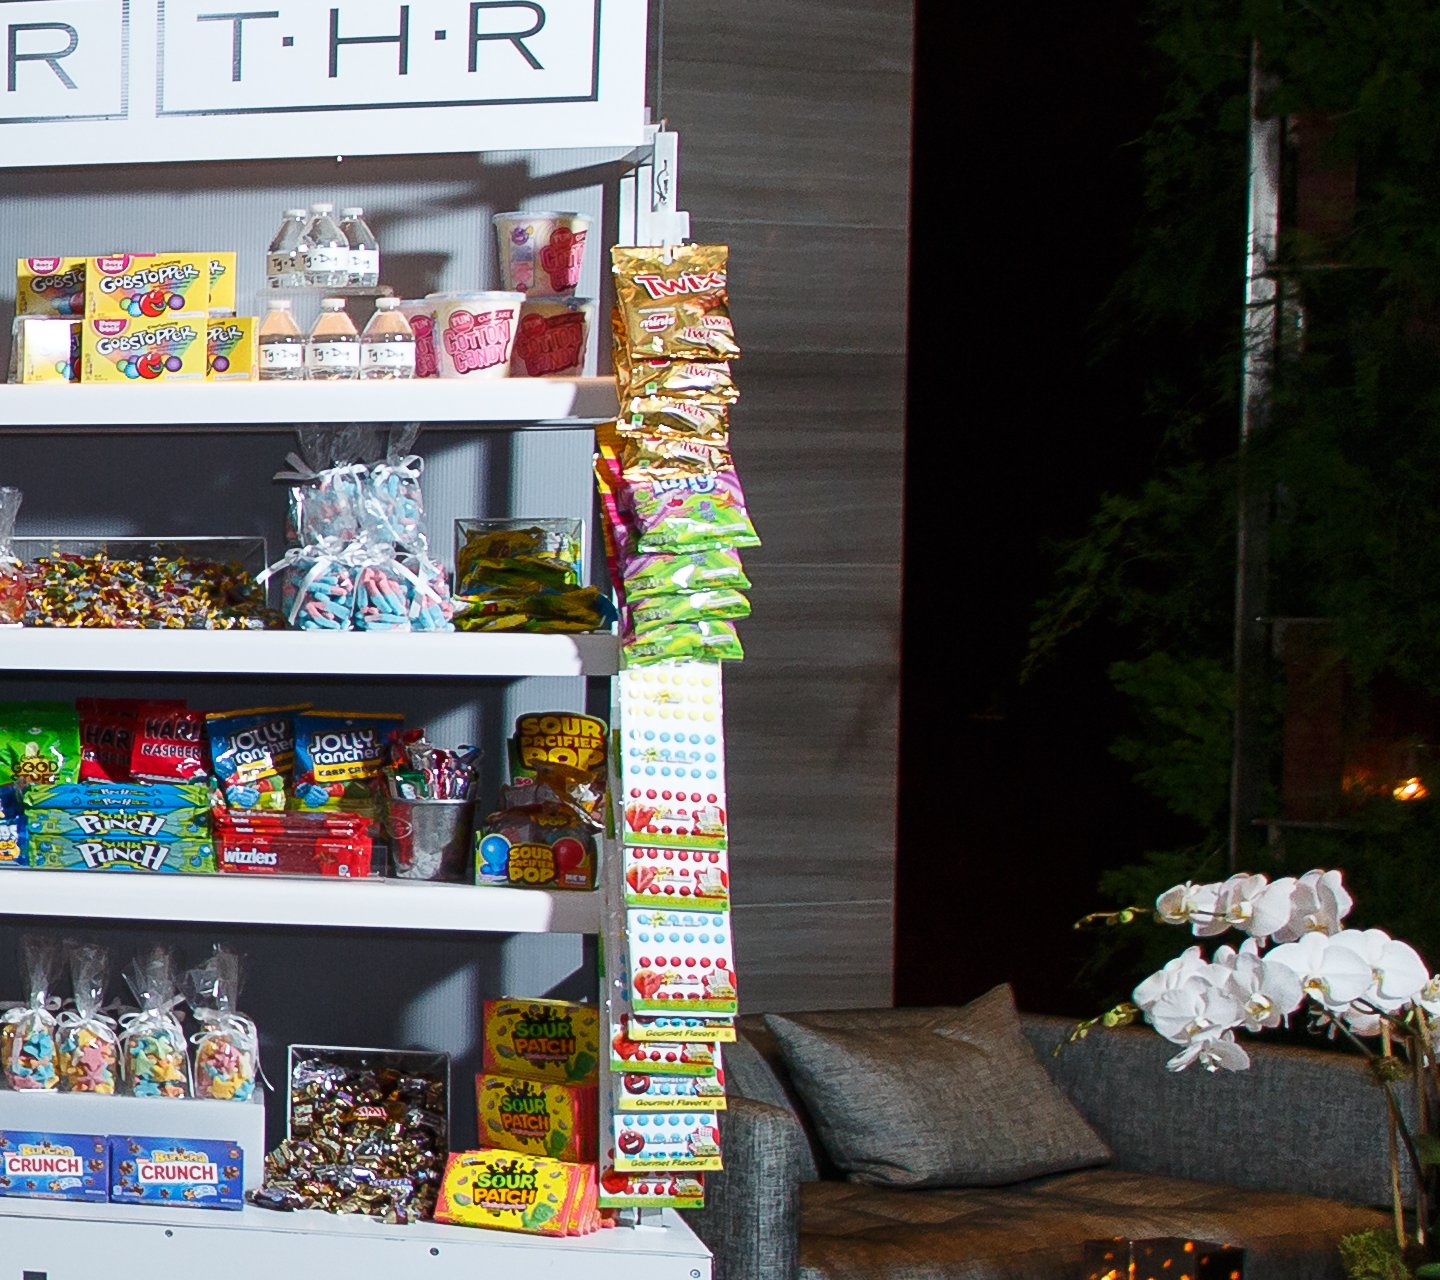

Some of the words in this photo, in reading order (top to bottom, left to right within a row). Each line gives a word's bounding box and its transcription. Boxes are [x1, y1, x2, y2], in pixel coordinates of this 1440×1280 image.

[451, 314, 472, 329] FUN
[639, 314, 676, 330] minis
[444, 320, 511, 352] COTTON
[520, 717, 603, 738] SOUR
[229, 721, 285, 754] JOLLY
[310, 728, 373, 753] JOLLY
[521, 736, 602, 749] PACIFIER
[314, 745, 381, 765] rancher
[522, 746, 605, 771] POP
[10, 761, 59, 774] GOOD
[73, 814, 168, 837] PUNCH
[76, 842, 170, 871] PUNCH
[223, 846, 278, 867] wizzlers
[509, 847, 553, 861] SOUR
[509, 868, 554, 883] POP
[516, 1022, 571, 1038] SOUR
[645, 1029, 684, 1038] Gourmet
[685, 1029, 719, 1038] Flavors!
[515, 1037, 575, 1054] PATCH
[502, 1098, 545, 1114] SOUR
[636, 1099, 676, 1107] Gourmet
[677, 1099, 712, 1107] Flavors!
[501, 1113, 550, 1130] PATCH
[8, 1158, 79, 1174] CRUNCH
[630, 1159, 671, 1168] Gourmet
[672, 1158, 708, 1167] Flavors!
[141, 1164, 214, 1181] CRUNCH
[477, 1172, 535, 1189] SOUR
[474, 1188, 536, 1204] PATCH
